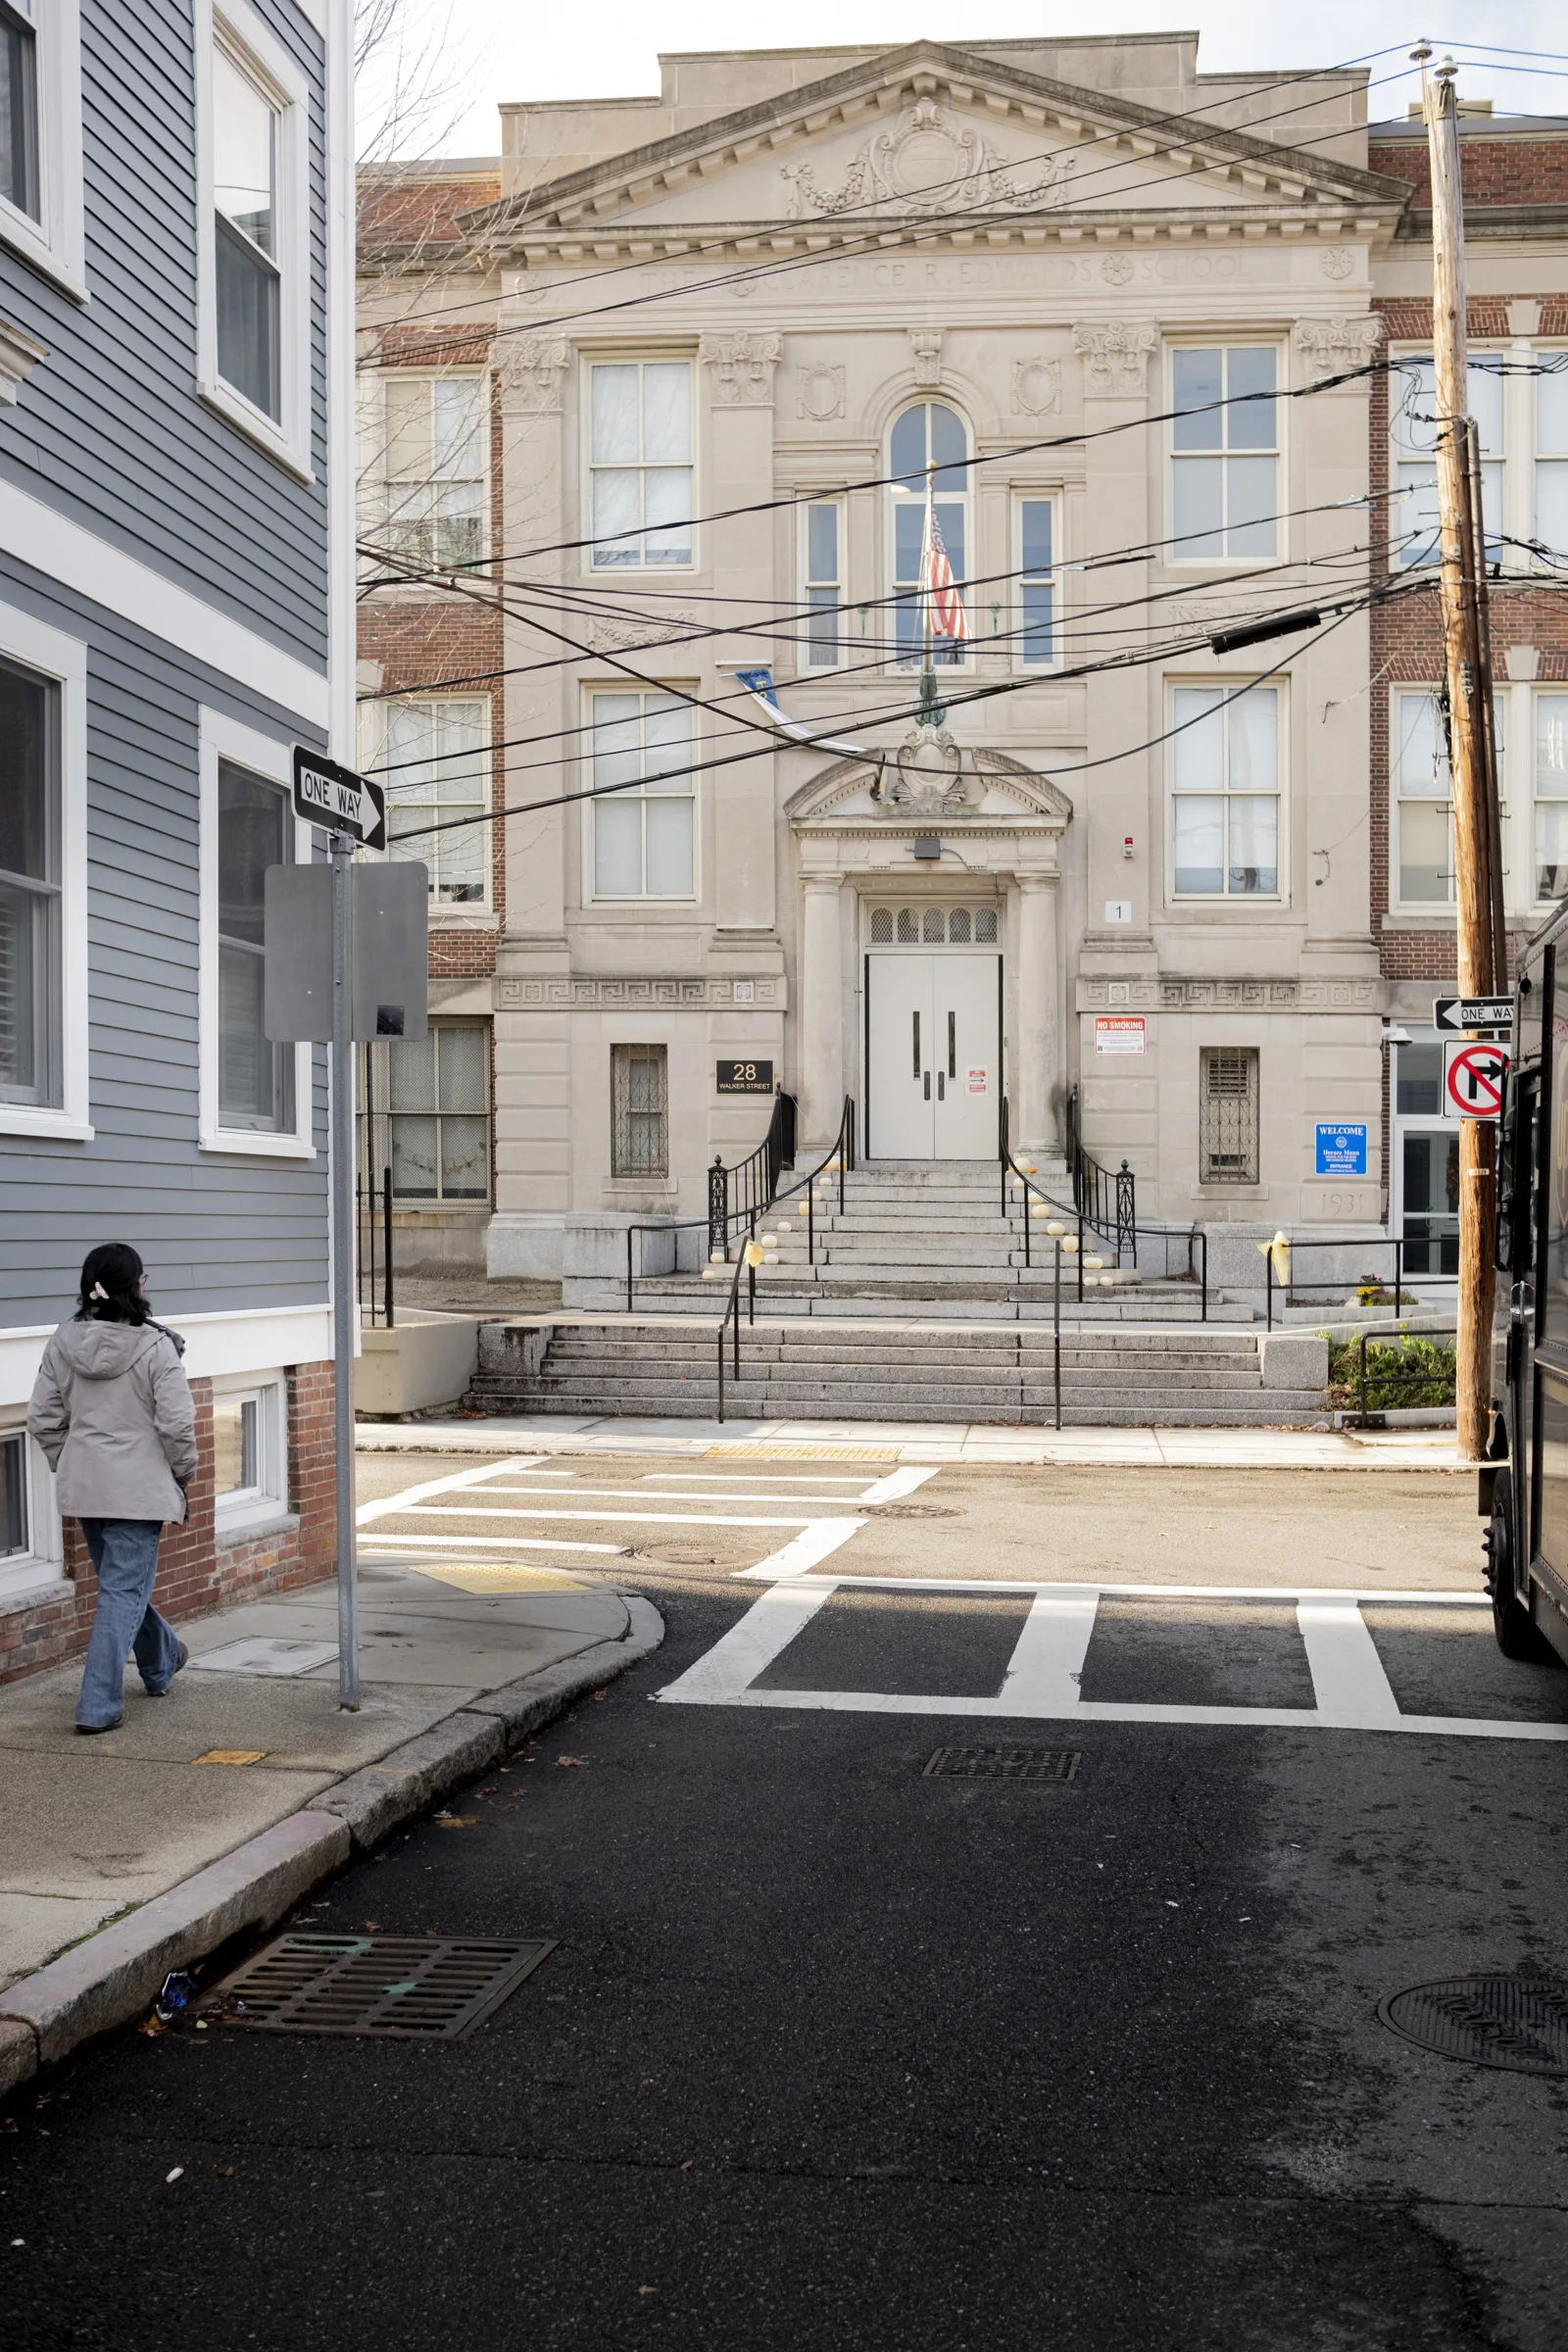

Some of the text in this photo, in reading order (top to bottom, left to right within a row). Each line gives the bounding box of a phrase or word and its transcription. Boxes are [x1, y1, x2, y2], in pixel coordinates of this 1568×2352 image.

[640, 270, 697, 295] THE
[959, 258, 1092, 285] EDWARDS
[1140, 255, 1251, 280] SCHOOL
[305, 772, 362, 820] ONE WAY
[1115, 905, 1122, 919] 1
[1461, 1007, 1485, 1020] ONE
[1097, 1021, 1144, 1030] NO SMOKING
[733, 1063, 757, 1081] 28
[1319, 1126, 1364, 1137] WELCOME
[1321, 1193, 1364, 1216] 1931
